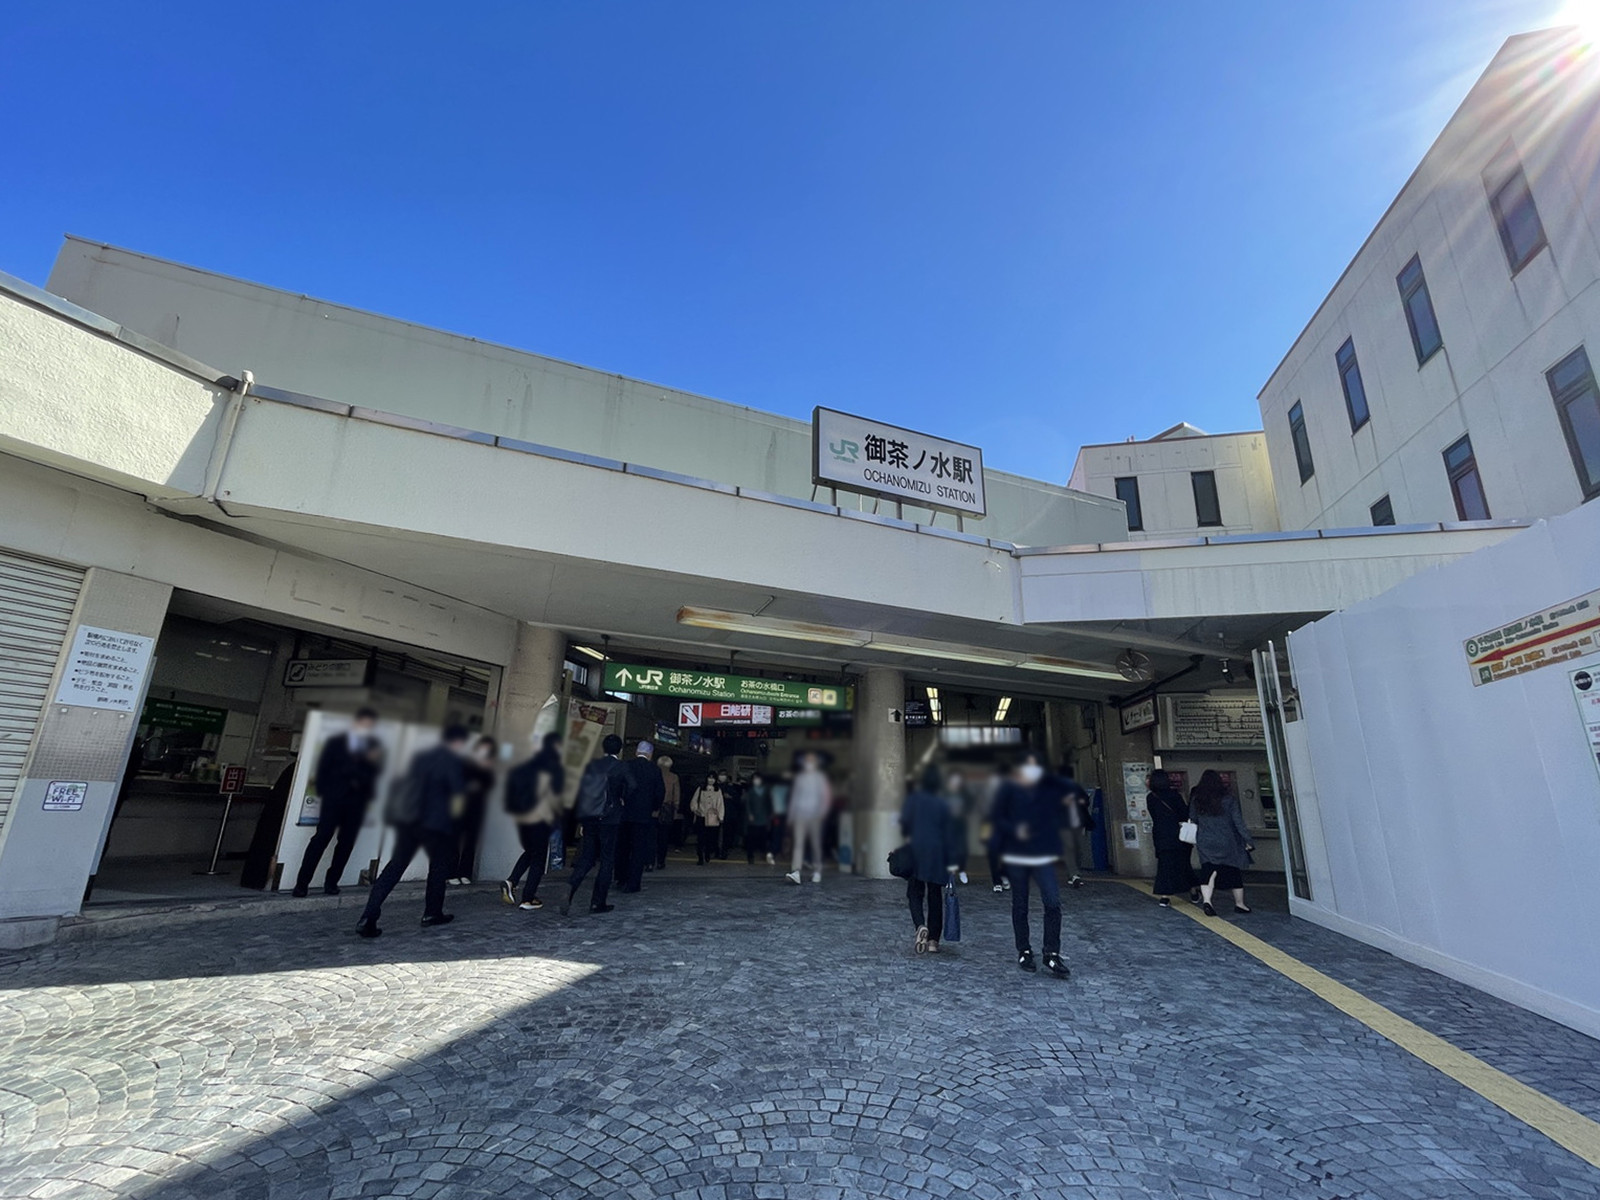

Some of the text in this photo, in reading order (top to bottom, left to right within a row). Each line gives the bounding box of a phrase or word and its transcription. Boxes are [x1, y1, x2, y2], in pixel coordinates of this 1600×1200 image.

[829, 439, 859, 460] JR
[865, 434, 974, 485] 御茶ノ水駅
[864, 468, 976, 504] OCHANOMIZU STATION
[636, 670, 664, 686] JR
[669, 672, 725, 689] 御茶ノ水駅
[740, 680, 785, 691] お茶の水橋口
[668, 685, 735, 698] Ochanomizu Station
[721, 704, 751, 717] 日能研
[53, 787, 79, 796] FREE
